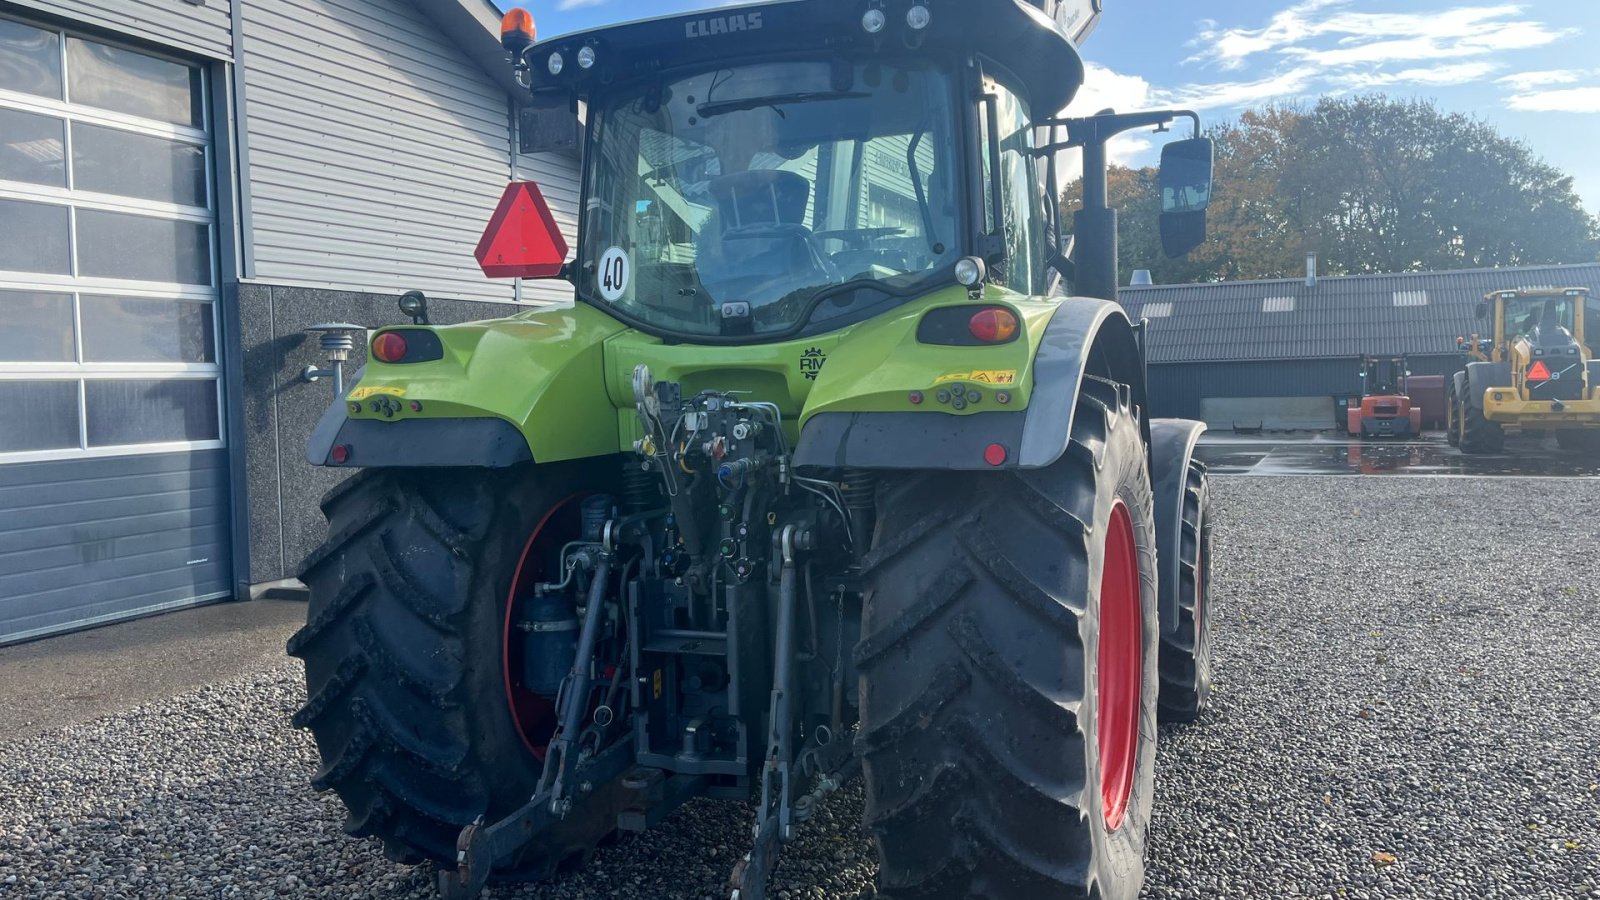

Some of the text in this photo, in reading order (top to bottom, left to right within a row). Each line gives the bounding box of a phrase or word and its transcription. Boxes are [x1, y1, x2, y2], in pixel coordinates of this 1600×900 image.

[685, 12, 762, 38] CLAAS
[603, 256, 623, 291] 40
[800, 358, 826, 370] RM
